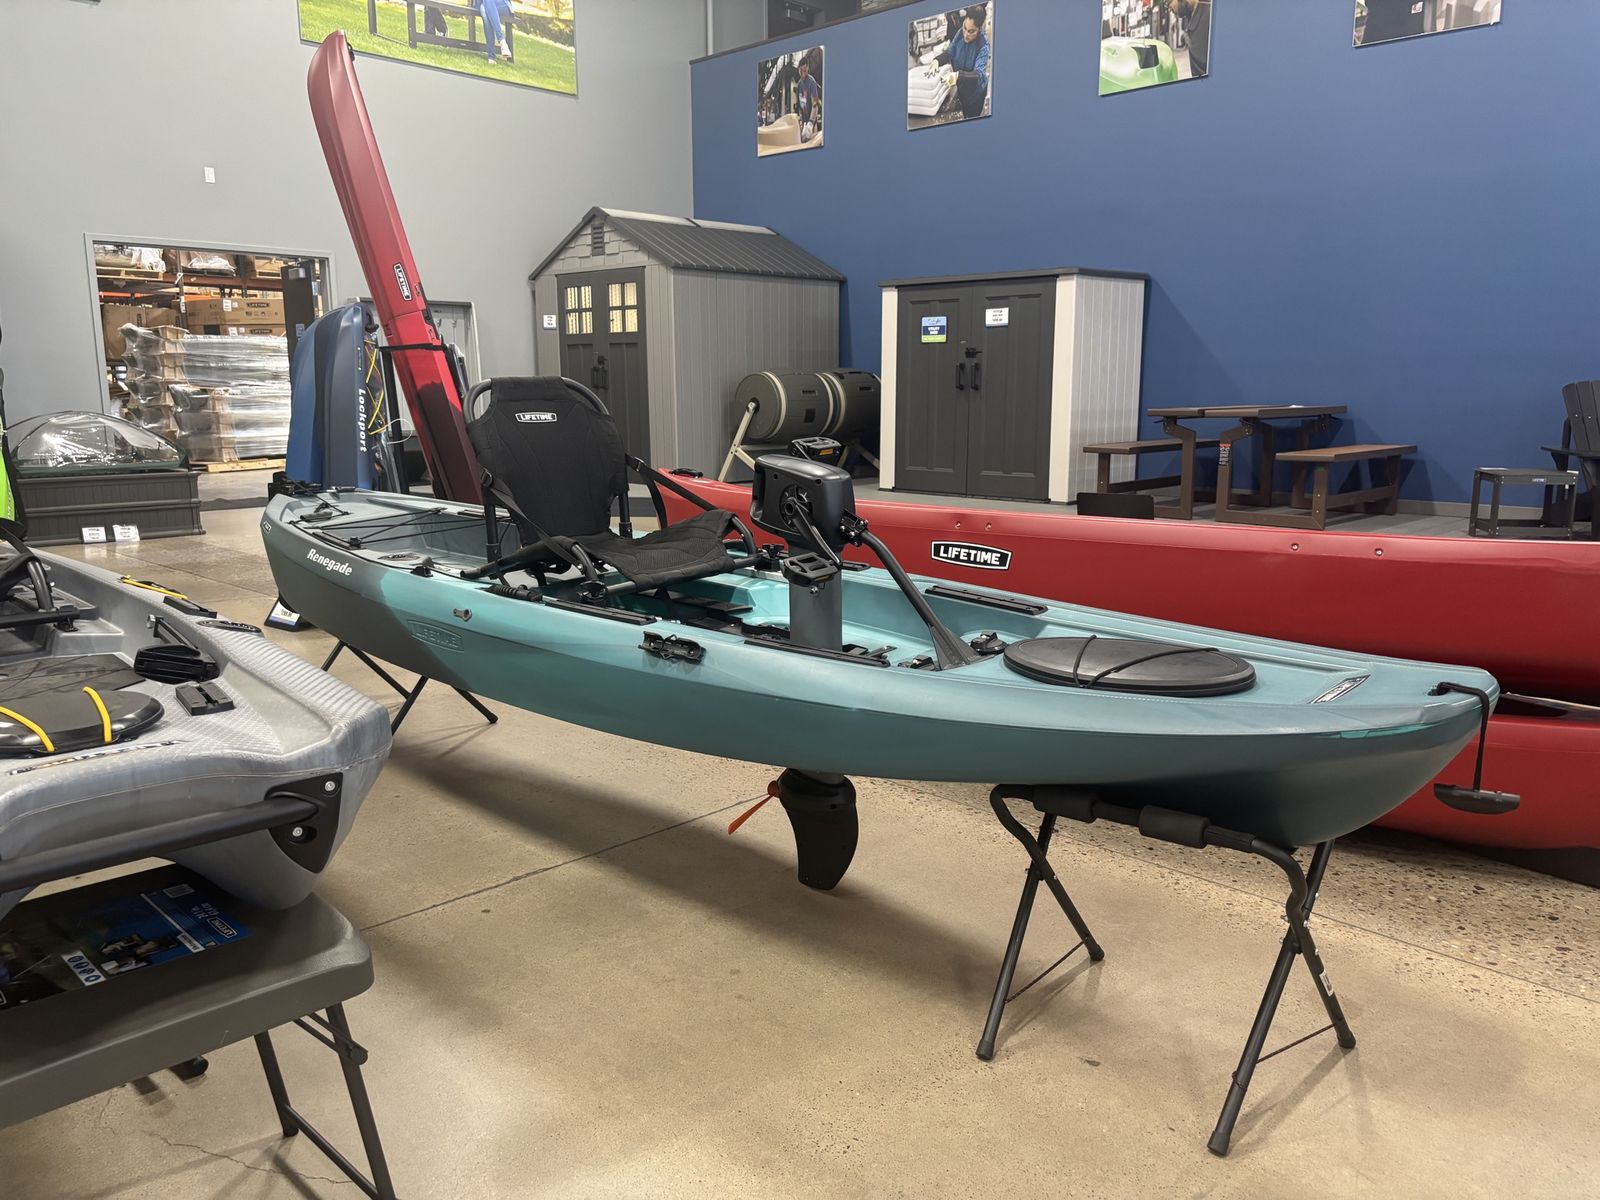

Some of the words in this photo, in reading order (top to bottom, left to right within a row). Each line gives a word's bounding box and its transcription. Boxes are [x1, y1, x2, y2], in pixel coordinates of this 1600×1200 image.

[358, 388, 368, 452] Lockport
[306, 548, 353, 576] Renegade
[939, 545, 1001, 565] LIFETIME
